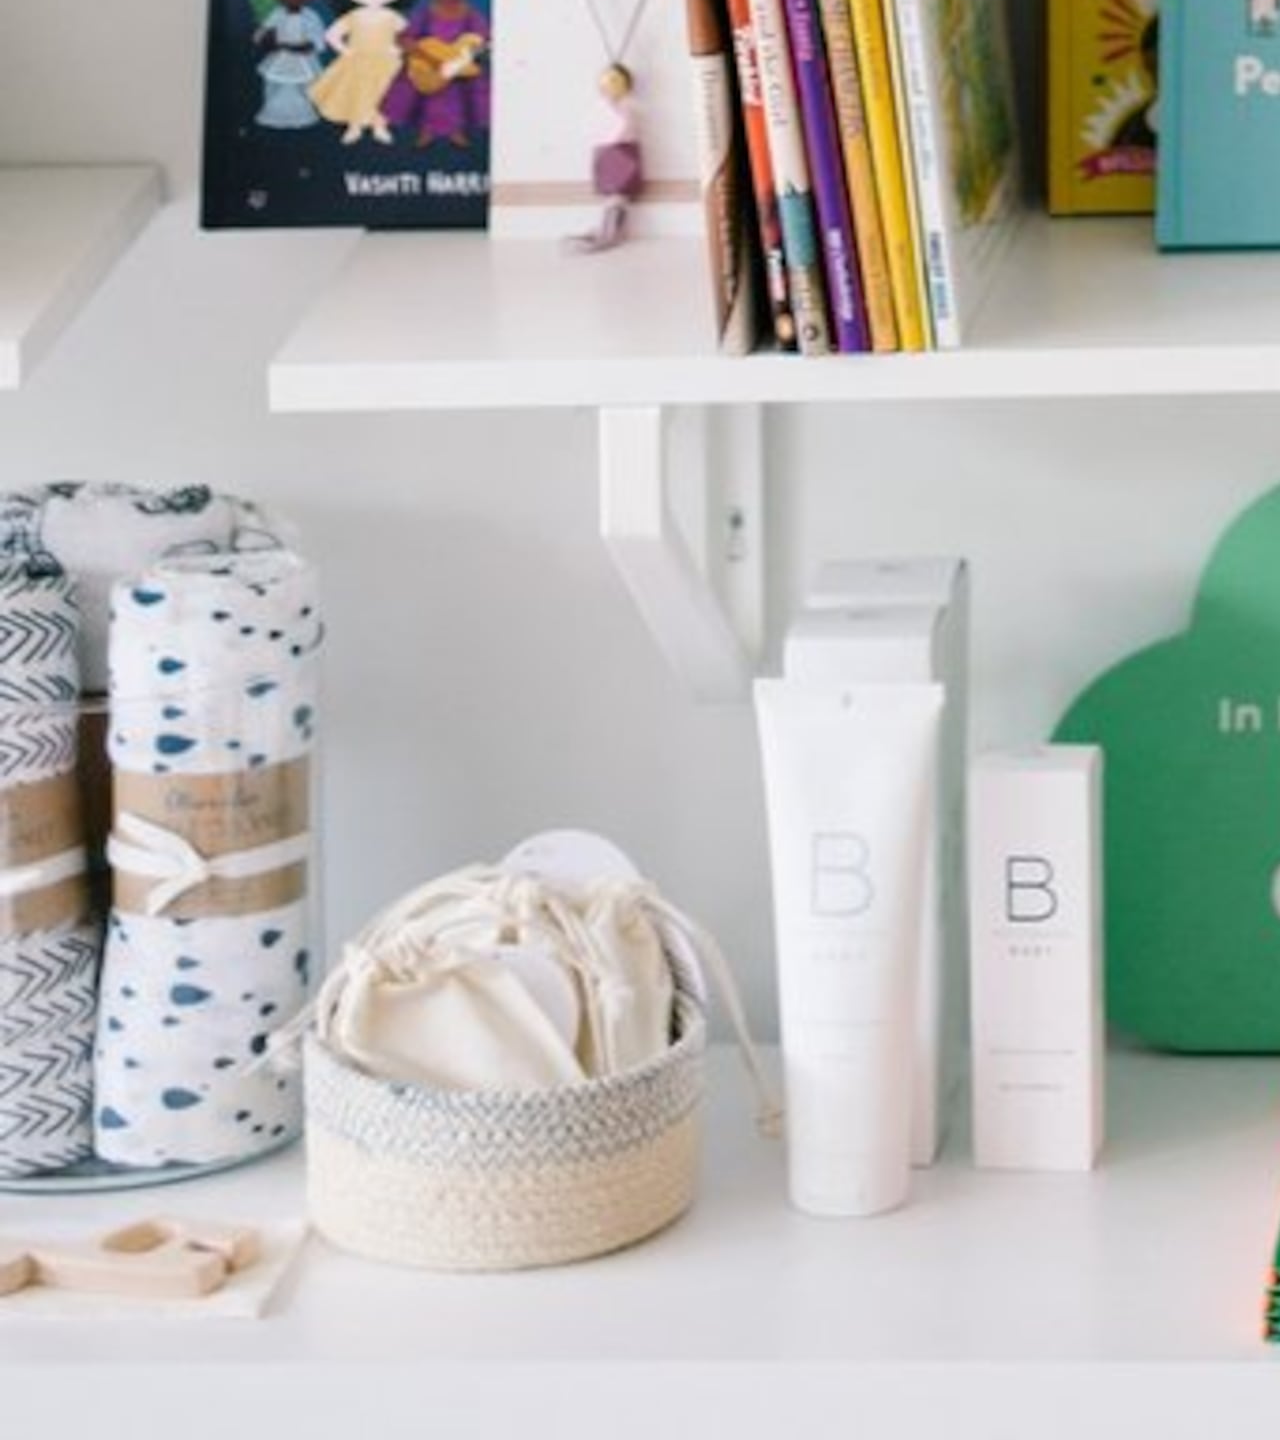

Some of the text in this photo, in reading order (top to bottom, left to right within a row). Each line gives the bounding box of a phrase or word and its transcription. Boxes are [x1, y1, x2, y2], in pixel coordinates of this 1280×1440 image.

[344, 171, 420, 197] VASHTI
[1218, 698, 1262, 733] In
[1006, 854, 1058, 924] B
